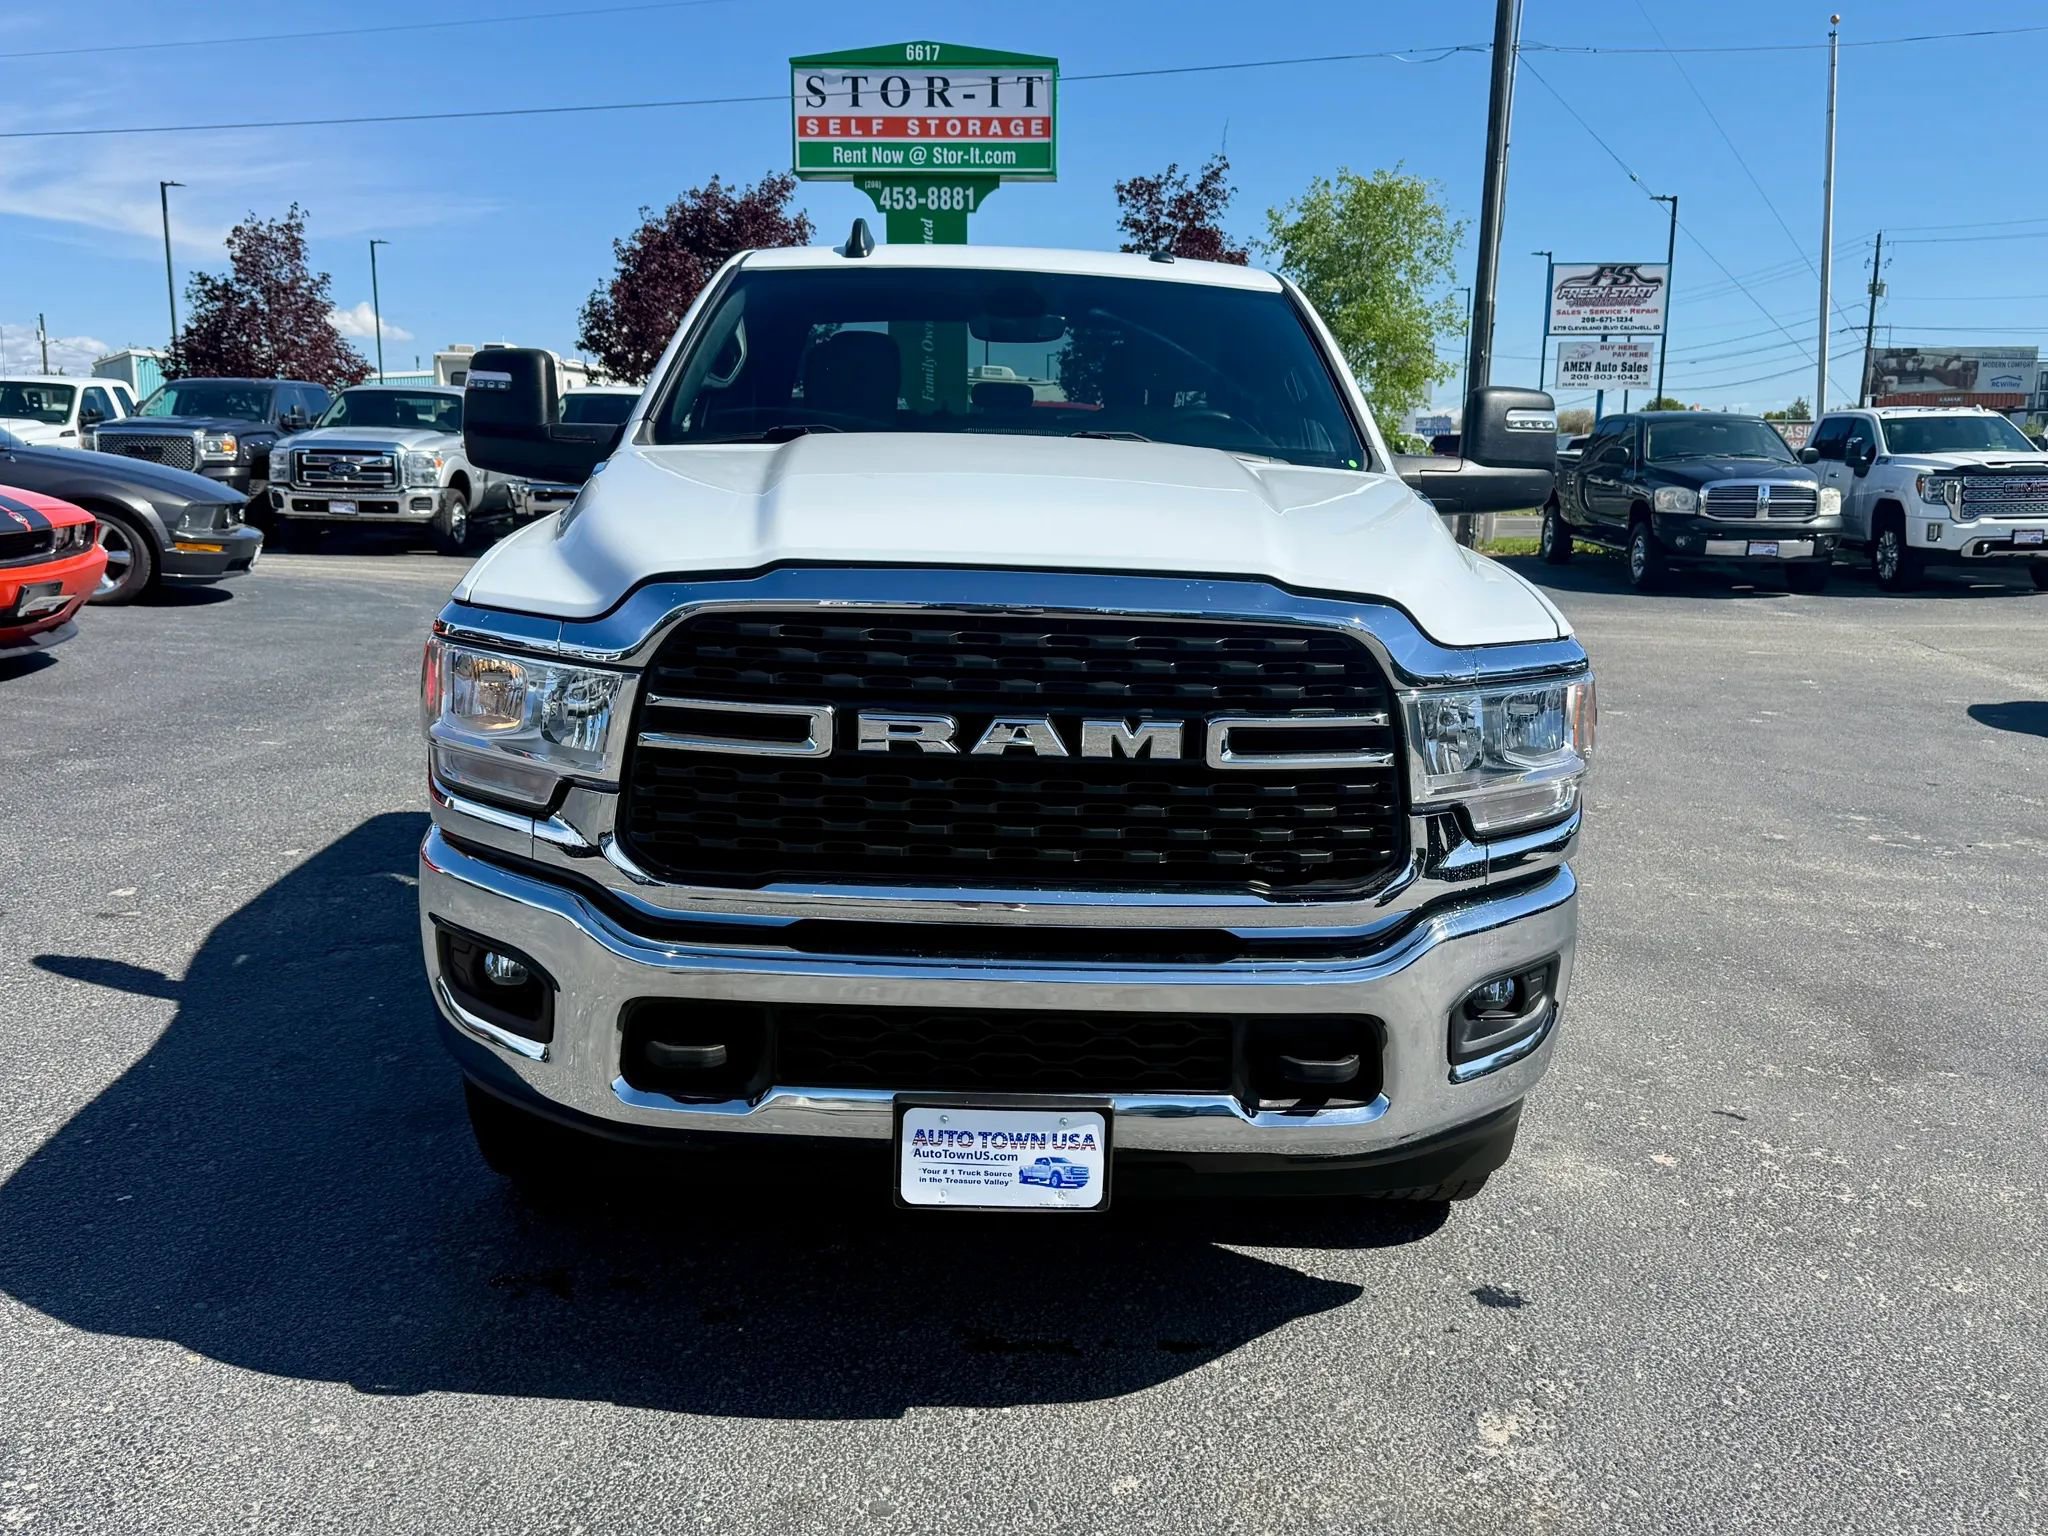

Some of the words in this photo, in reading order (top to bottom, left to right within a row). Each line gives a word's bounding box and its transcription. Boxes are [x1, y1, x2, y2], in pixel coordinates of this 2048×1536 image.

[906, 45, 940, 61] 6617
[805, 75, 1044, 108] STOR-IT
[806, 119, 884, 135] SELF
[907, 119, 1043, 136] STORAGE
[833, 147, 867, 163] Rent
[872, 148, 904, 164] Now
[909, 147, 927, 165] @
[933, 147, 1016, 164] Stor-It.com
[880, 187, 975, 210] 453-8881
[1557, 286, 1610, 300] FRESH
[1608, 286, 1658, 299] START
[922, 321, 935, 351] Own
[1562, 361, 1592, 373] AMEN
[1594, 361, 1617, 372] Auto
[1620, 361, 1648, 373] Sales
[922, 356, 937, 401] Family
[857, 713, 1185, 760] RAM
[911, 1128, 975, 1148] AUTO
[978, 1131, 1046, 1150] TOWN
[1052, 1133, 1097, 1151] USA
[913, 1149, 1018, 1162] AutoTownUS.com
[984, 1170, 1013, 1178] Source
